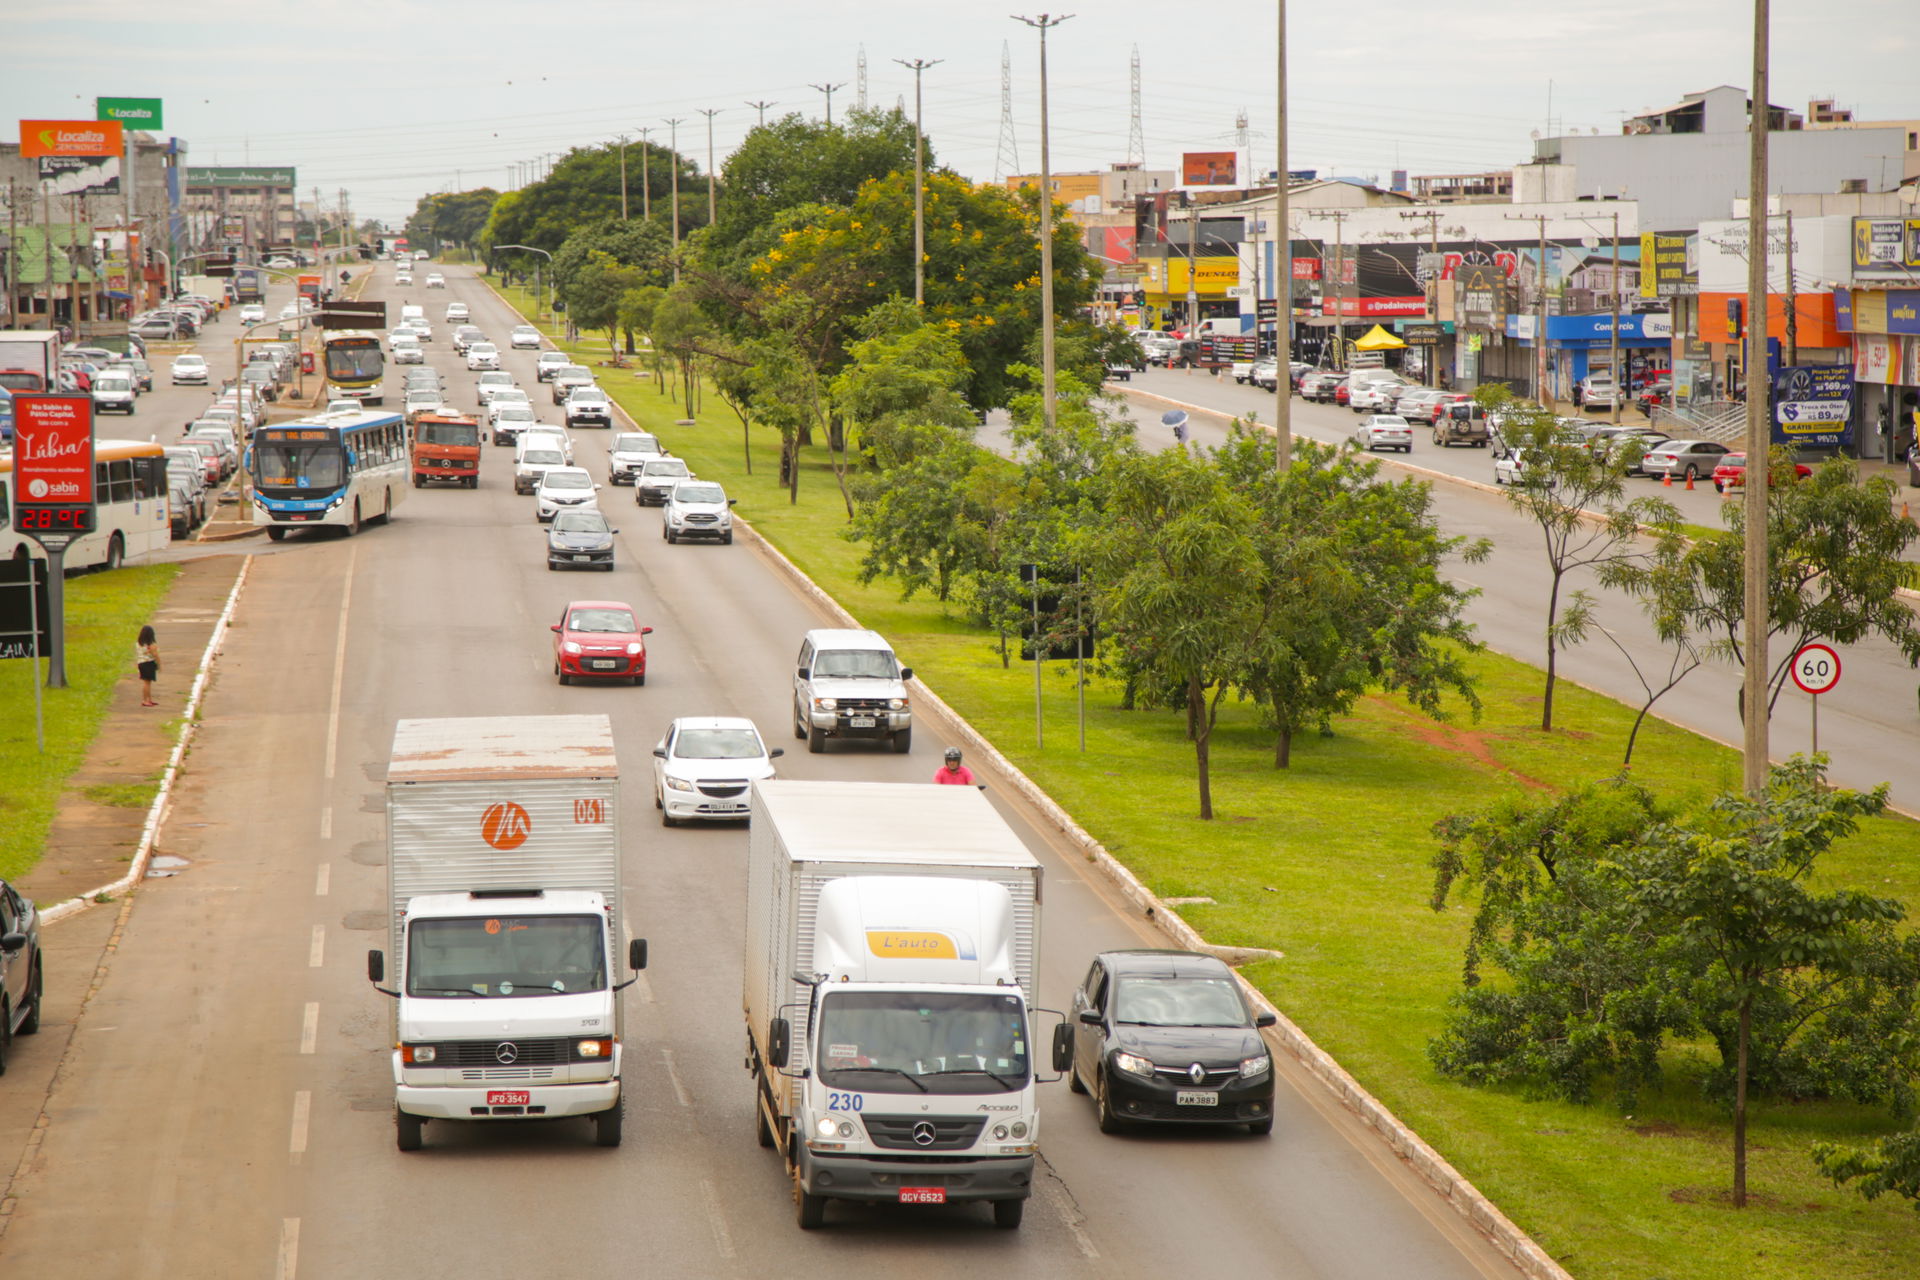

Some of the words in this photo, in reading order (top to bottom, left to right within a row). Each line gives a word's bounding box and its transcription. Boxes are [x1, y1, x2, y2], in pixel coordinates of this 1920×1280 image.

[115, 109, 152, 118] Localiza
[57, 130, 105, 142] Localiza
[49, 481, 80, 493] sabin
[22, 509, 52, 529] 28
[1803, 660, 1828, 677] 60
[578, 800, 604, 823] 061
[883, 936, 939, 948] L'auto
[829, 1093, 863, 1112] 230
